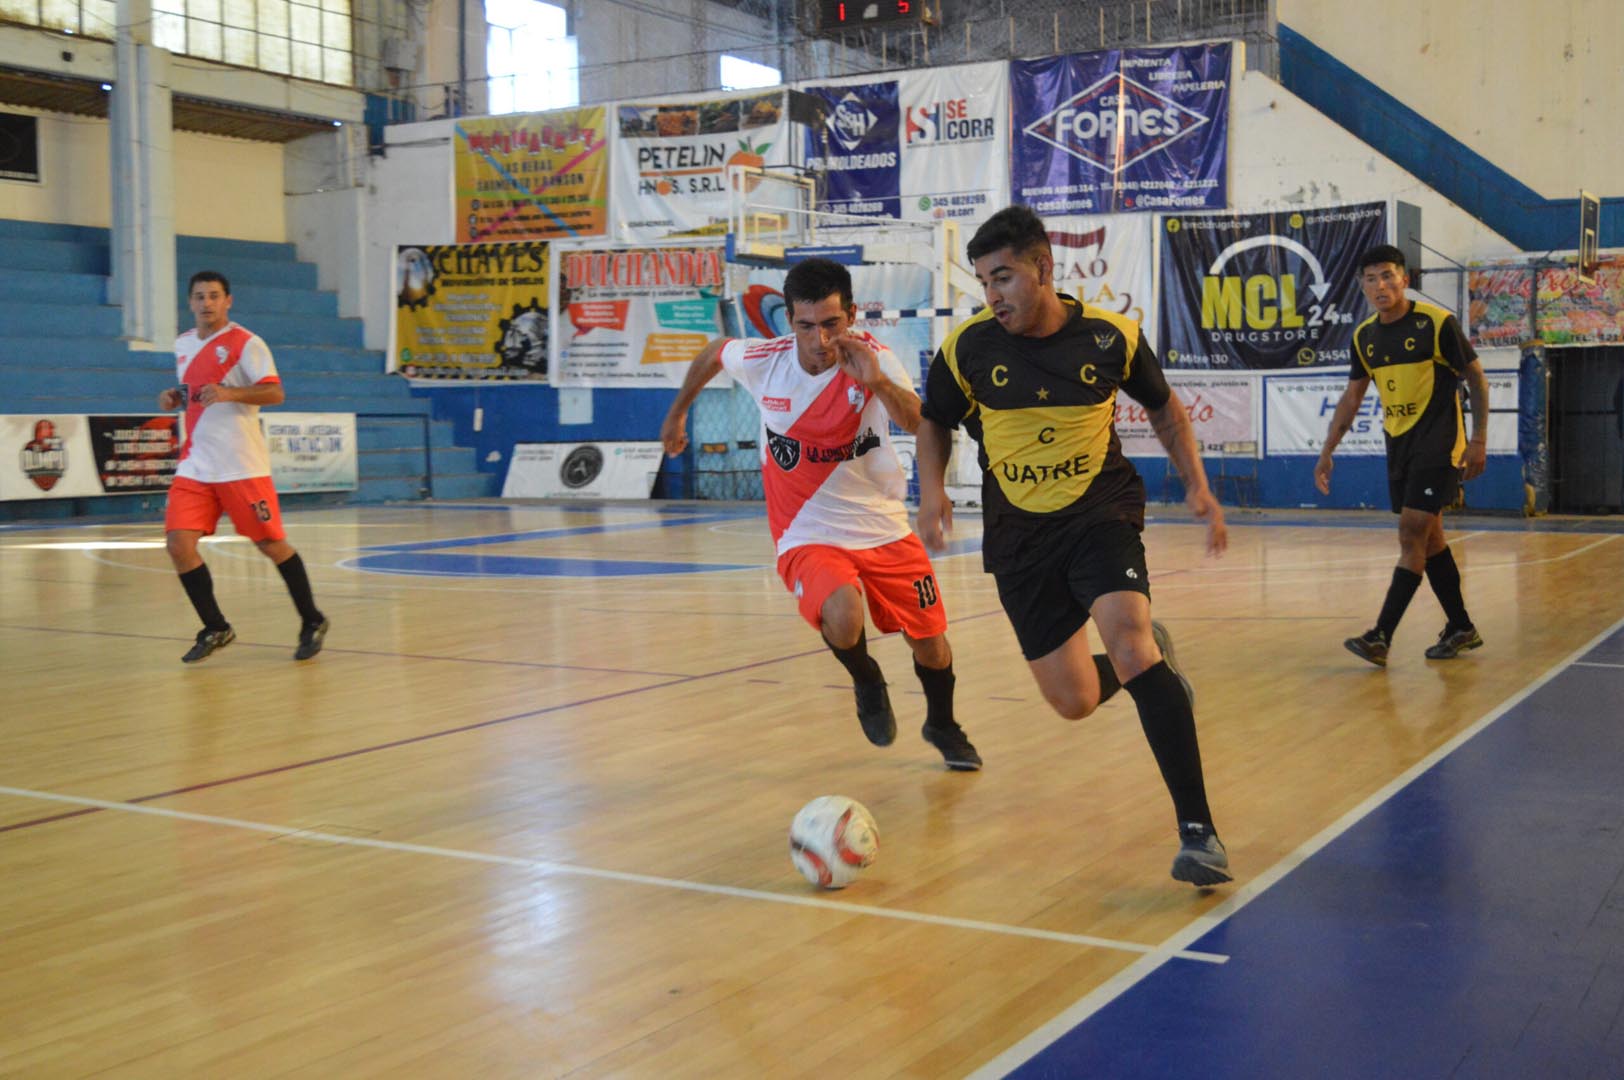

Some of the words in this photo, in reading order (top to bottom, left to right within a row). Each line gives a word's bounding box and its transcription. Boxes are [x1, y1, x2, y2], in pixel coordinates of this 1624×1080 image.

[1120, 57, 1172, 69] IMPRENTA
[1172, 80, 1226, 92] PAPELERIA
[946, 99, 967, 119] SE
[1099, 94, 1132, 107] CASA
[947, 118, 995, 140] CORR
[1055, 107, 1181, 152] FORNES
[638, 143, 727, 170] PETELIN
[437, 246, 545, 275] CHAVES
[1201, 273, 1305, 330] MCL
[1307, 303, 1341, 327] 24
[1211, 328, 1320, 343] DRUGSTORE
[1404, 337, 1416, 351] C
[1210, 353, 1229, 365] 130
[1366, 343, 1374, 358] C
[991, 364, 1009, 387] C
[1080, 363, 1097, 385] C
[1386, 379, 1396, 392] C
[1038, 427, 1056, 444] C
[1003, 454, 1090, 484] UATRE
[913, 574, 937, 609] 10
